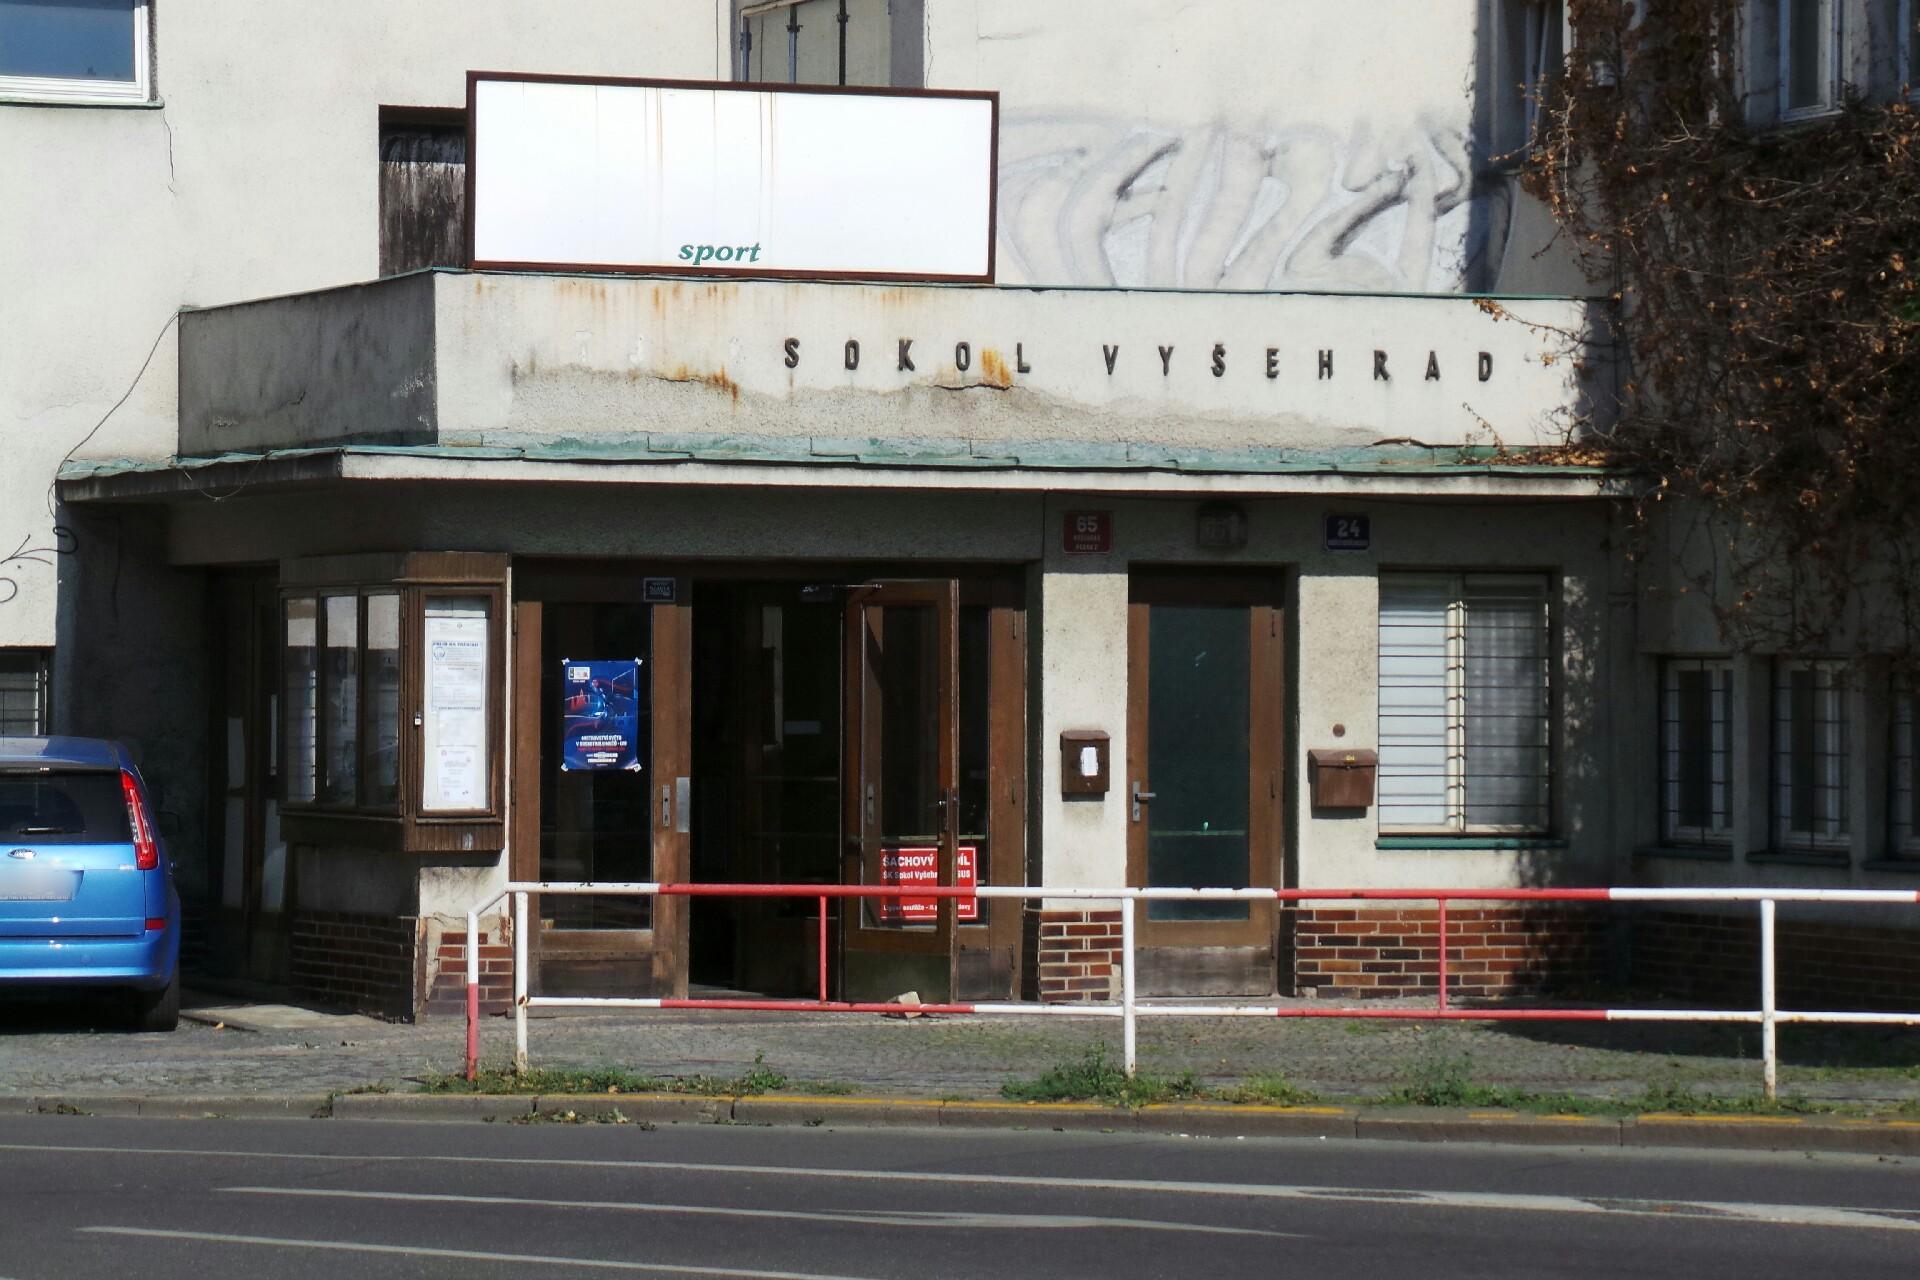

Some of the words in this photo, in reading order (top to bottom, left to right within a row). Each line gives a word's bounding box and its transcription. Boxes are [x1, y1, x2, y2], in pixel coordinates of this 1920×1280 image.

[678, 242, 761, 265] sport
[785, 337, 1031, 374] SOKOL
[1102, 343, 1494, 382] VYŠEHRAD
[1076, 515, 1098, 533] 65
[1336, 519, 1361, 537] 24
[882, 853, 935, 867] ŠACHOVÝ
[883, 870, 893, 880] ŠK
[895, 870, 914, 880] Sokol
